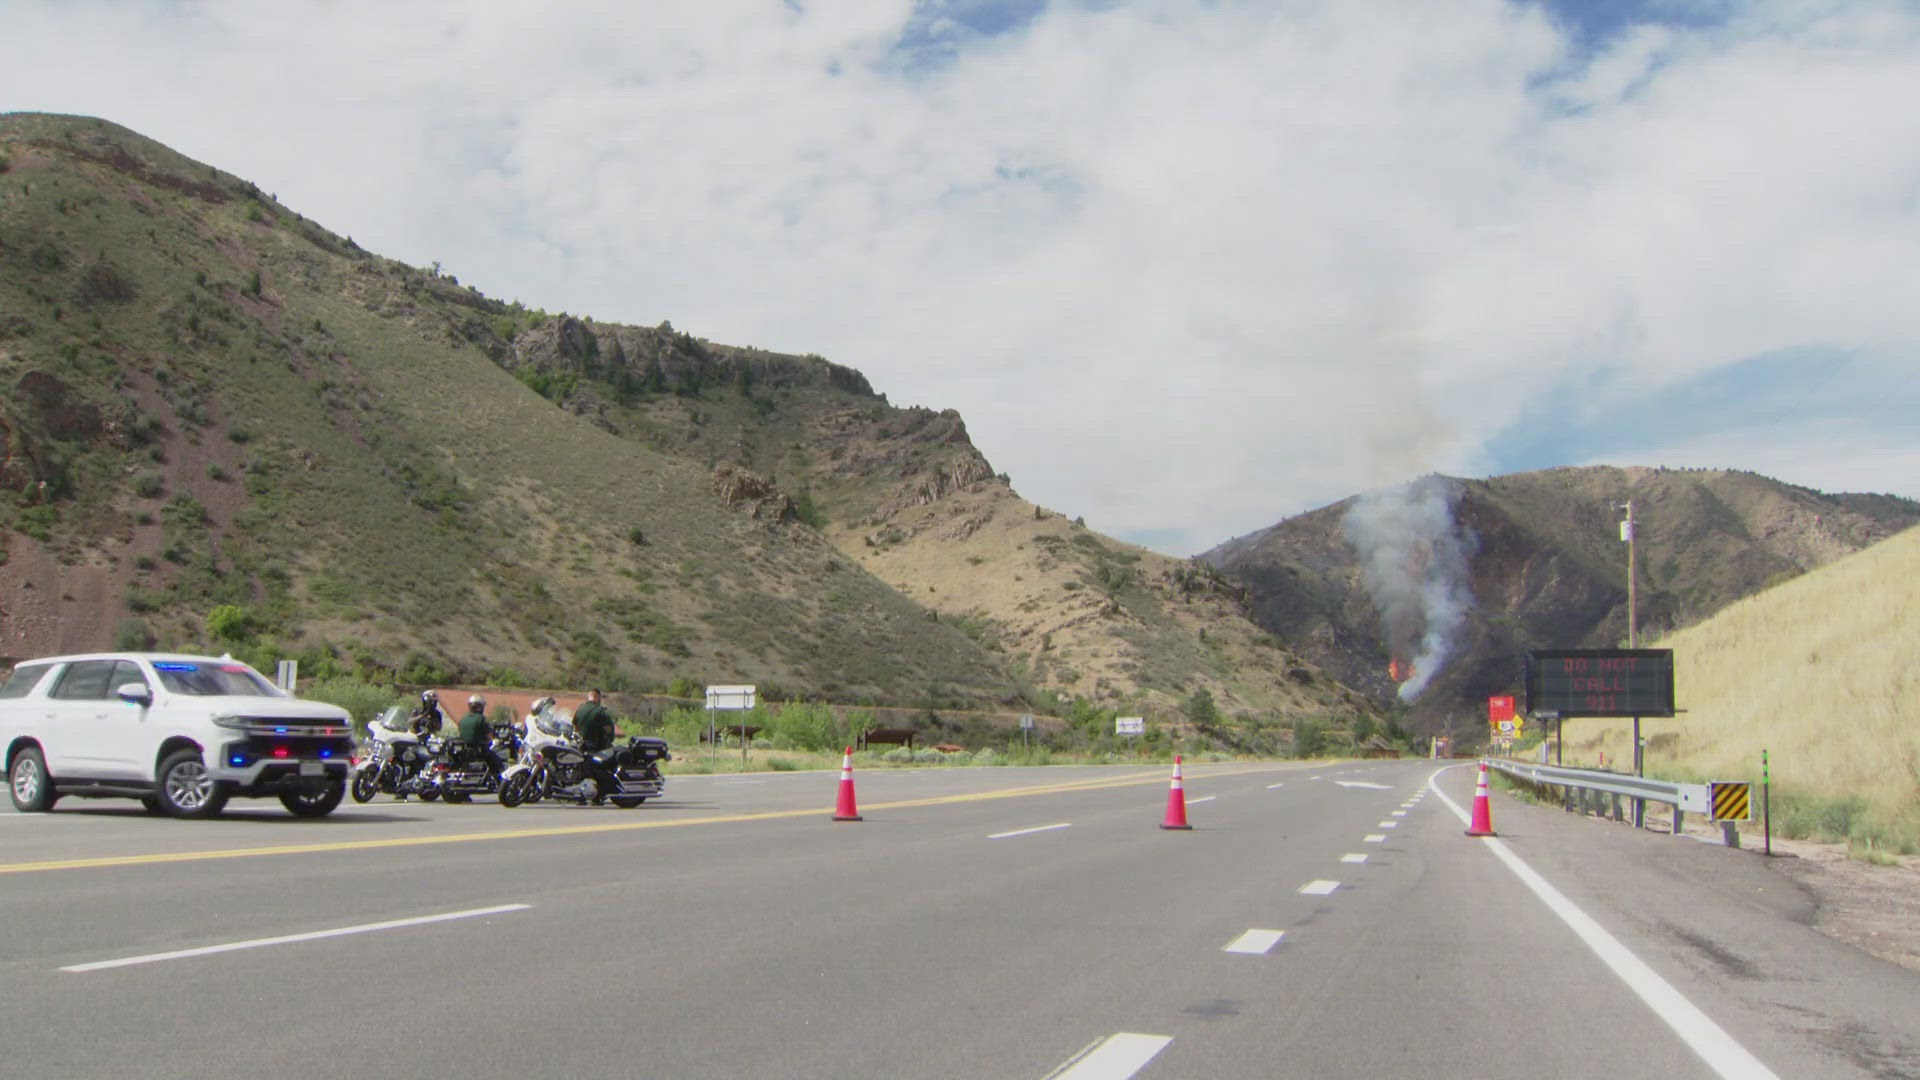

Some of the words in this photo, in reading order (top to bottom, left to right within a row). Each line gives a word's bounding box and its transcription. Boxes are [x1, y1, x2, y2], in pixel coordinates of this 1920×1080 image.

[1563, 657, 1587, 672] DO
[1600, 657, 1638, 672] NOT
[1575, 677, 1625, 692] CALL
[1586, 695, 1617, 711] 911
